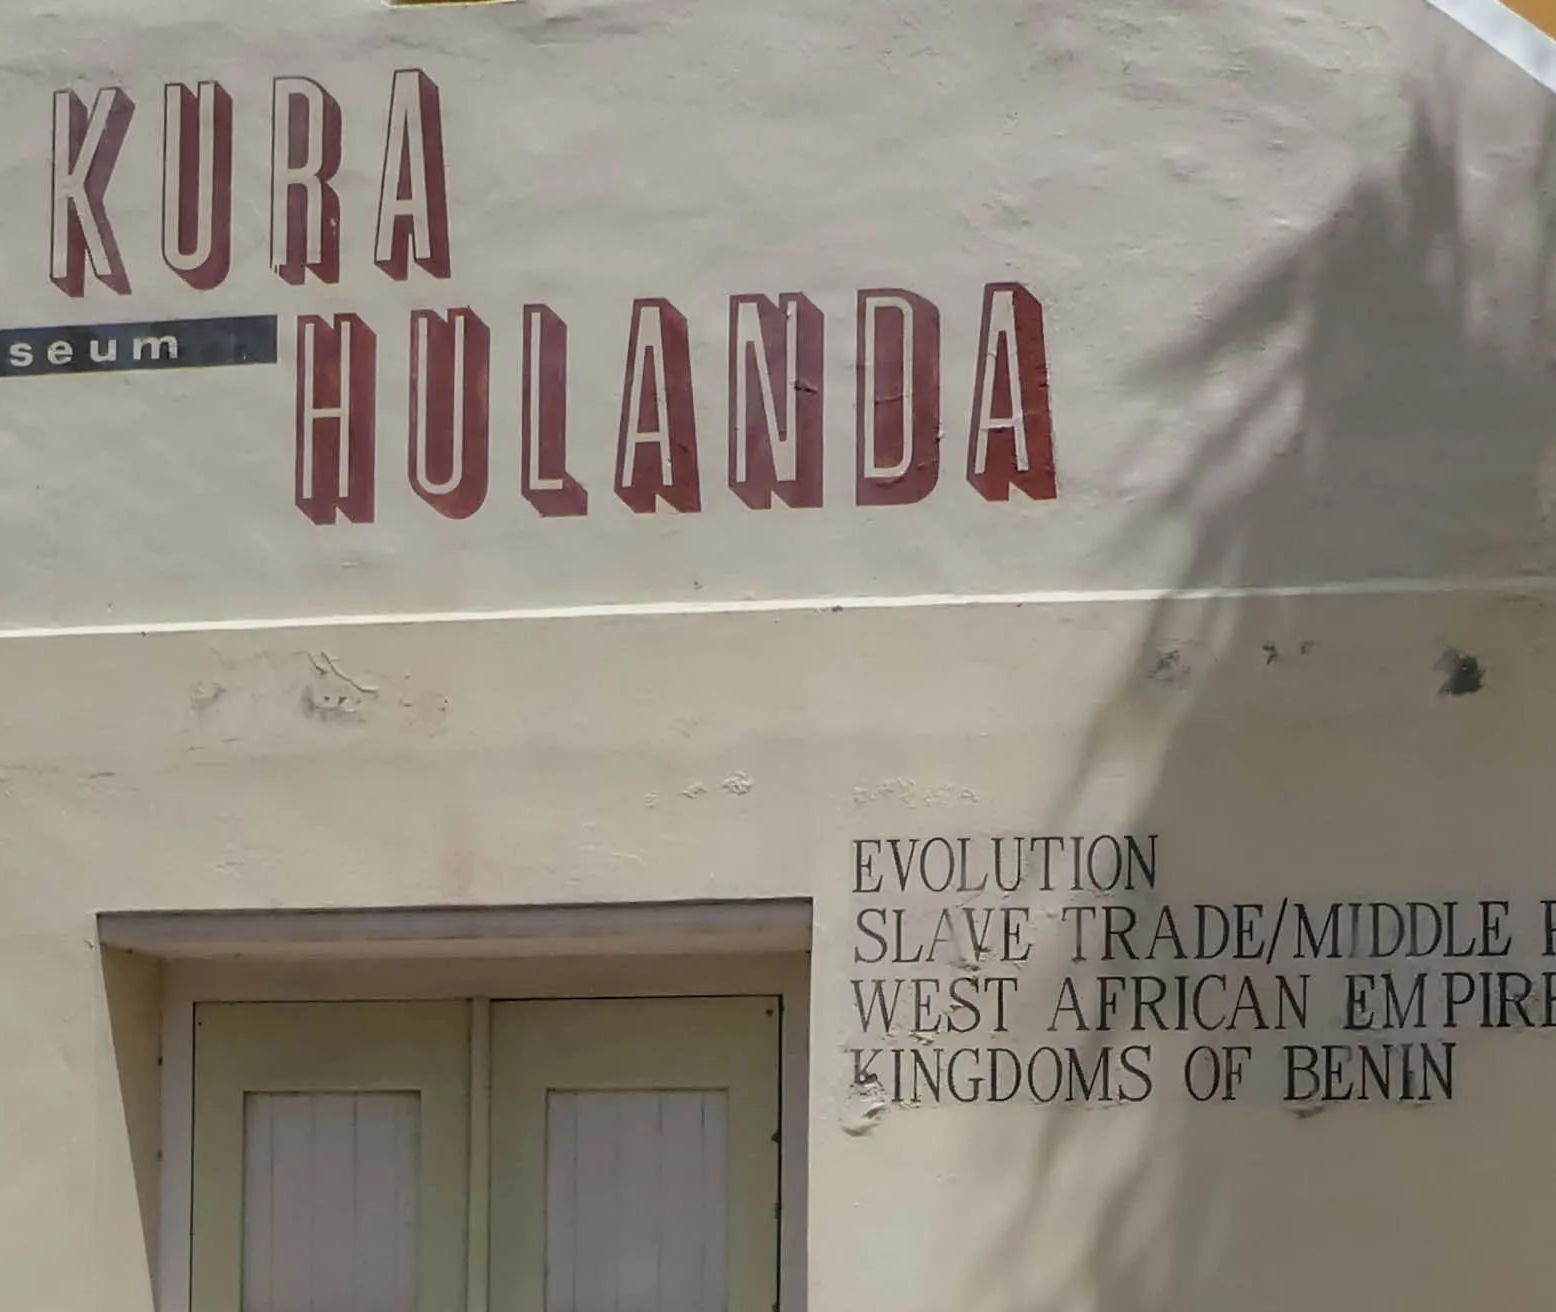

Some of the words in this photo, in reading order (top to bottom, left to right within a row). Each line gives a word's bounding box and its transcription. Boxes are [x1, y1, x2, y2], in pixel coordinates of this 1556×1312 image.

[47, 68, 452, 297] KURA
[294, 281, 1058, 526] HULANDA
[851, 834, 1160, 893] EVOLUTION
[853, 906, 1033, 964] SLAVE
[1061, 897, 1513, 965] TRADE/MIDDLE
[850, 976, 1019, 1033] WEST
[1046, 974, 1311, 1032] AFRICAN
[849, 1044, 1153, 1103] KINGDOMS
[1184, 1045, 1252, 1101] OF
[1282, 1042, 1457, 1102] BENIN
